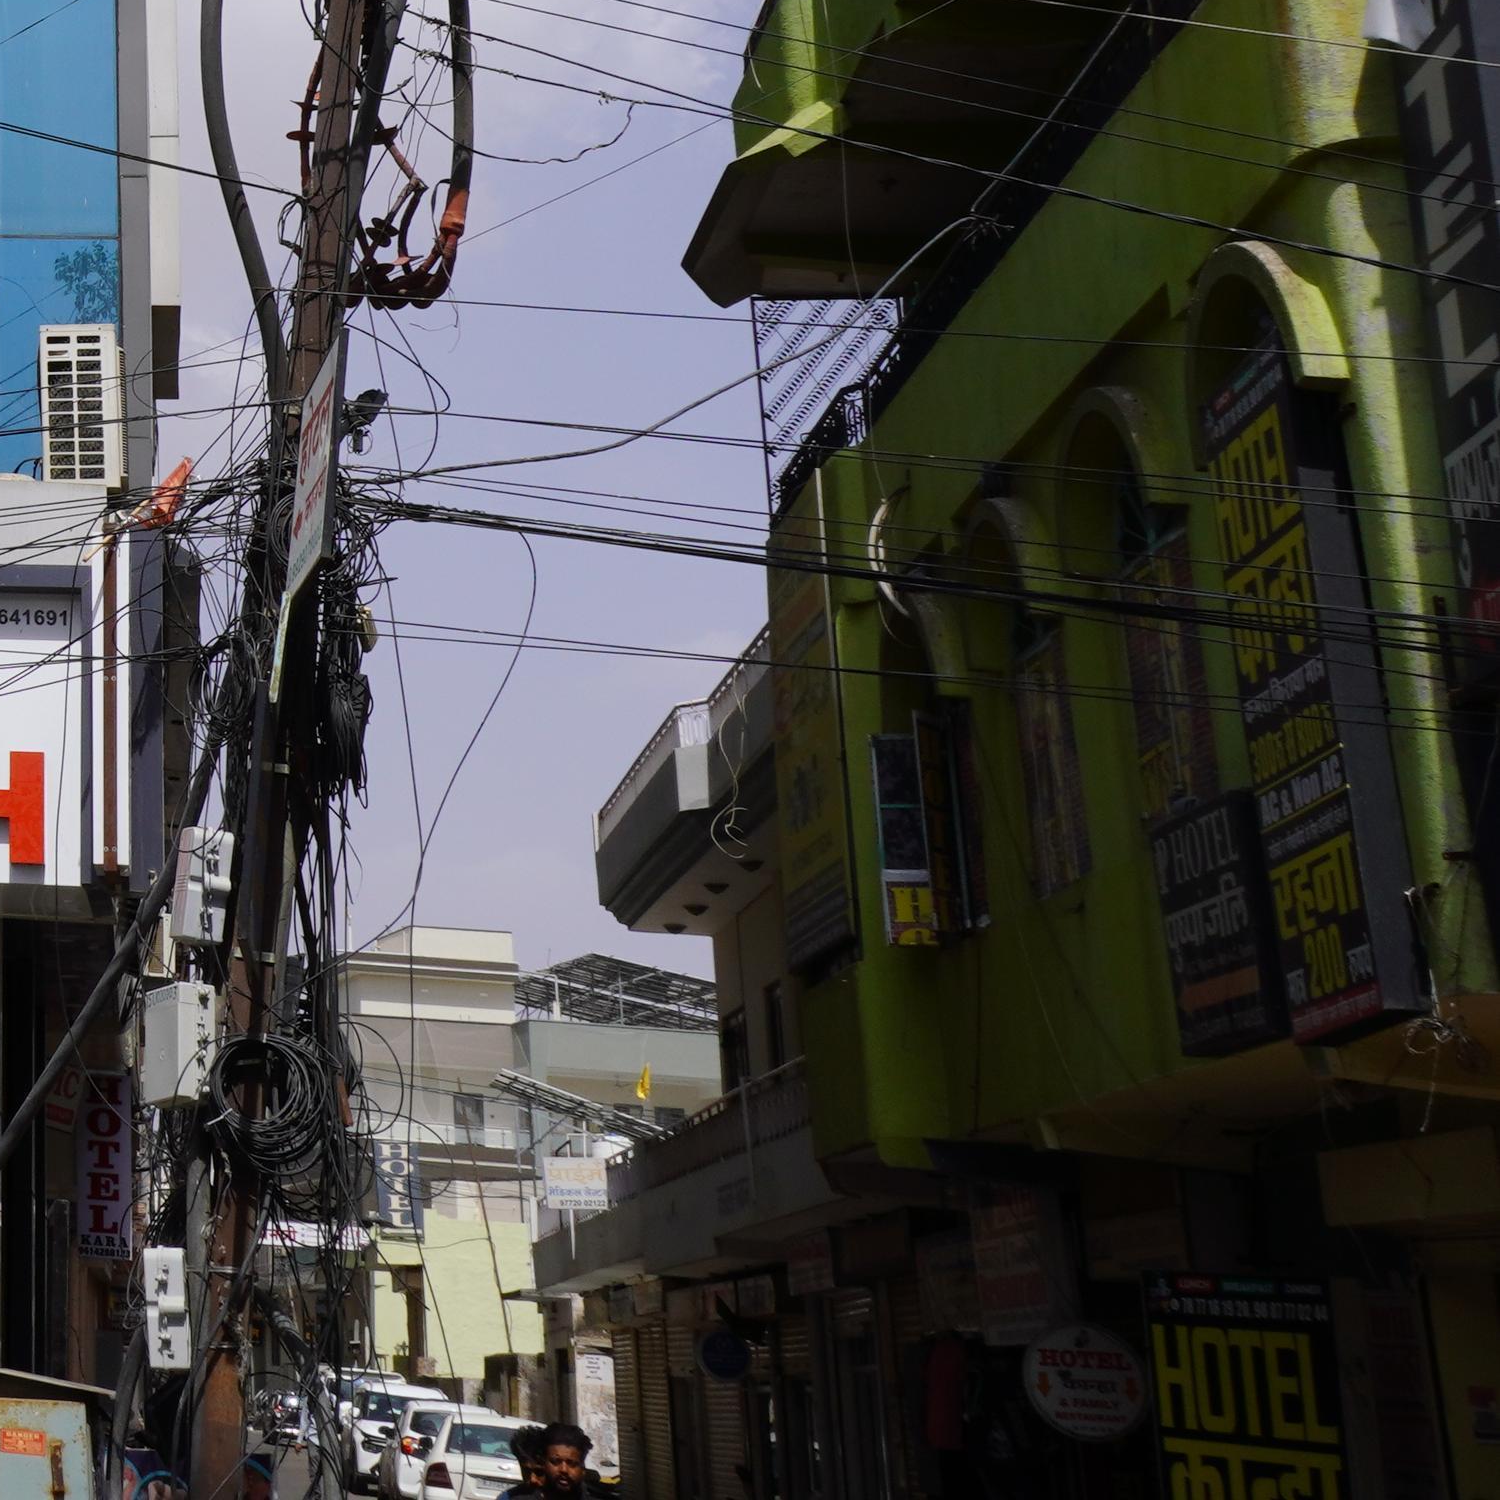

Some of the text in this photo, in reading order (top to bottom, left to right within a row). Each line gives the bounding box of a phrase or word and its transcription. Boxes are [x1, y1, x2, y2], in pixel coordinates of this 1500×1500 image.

[1168, 806, 1240, 885] HOTEL
[86, 1077, 123, 1235] HOTEL
[377, 1141, 414, 1229] HOTEL
[1037, 1348, 1133, 1372] HOTEL
[1150, 1322, 1341, 1445] HOTEL
